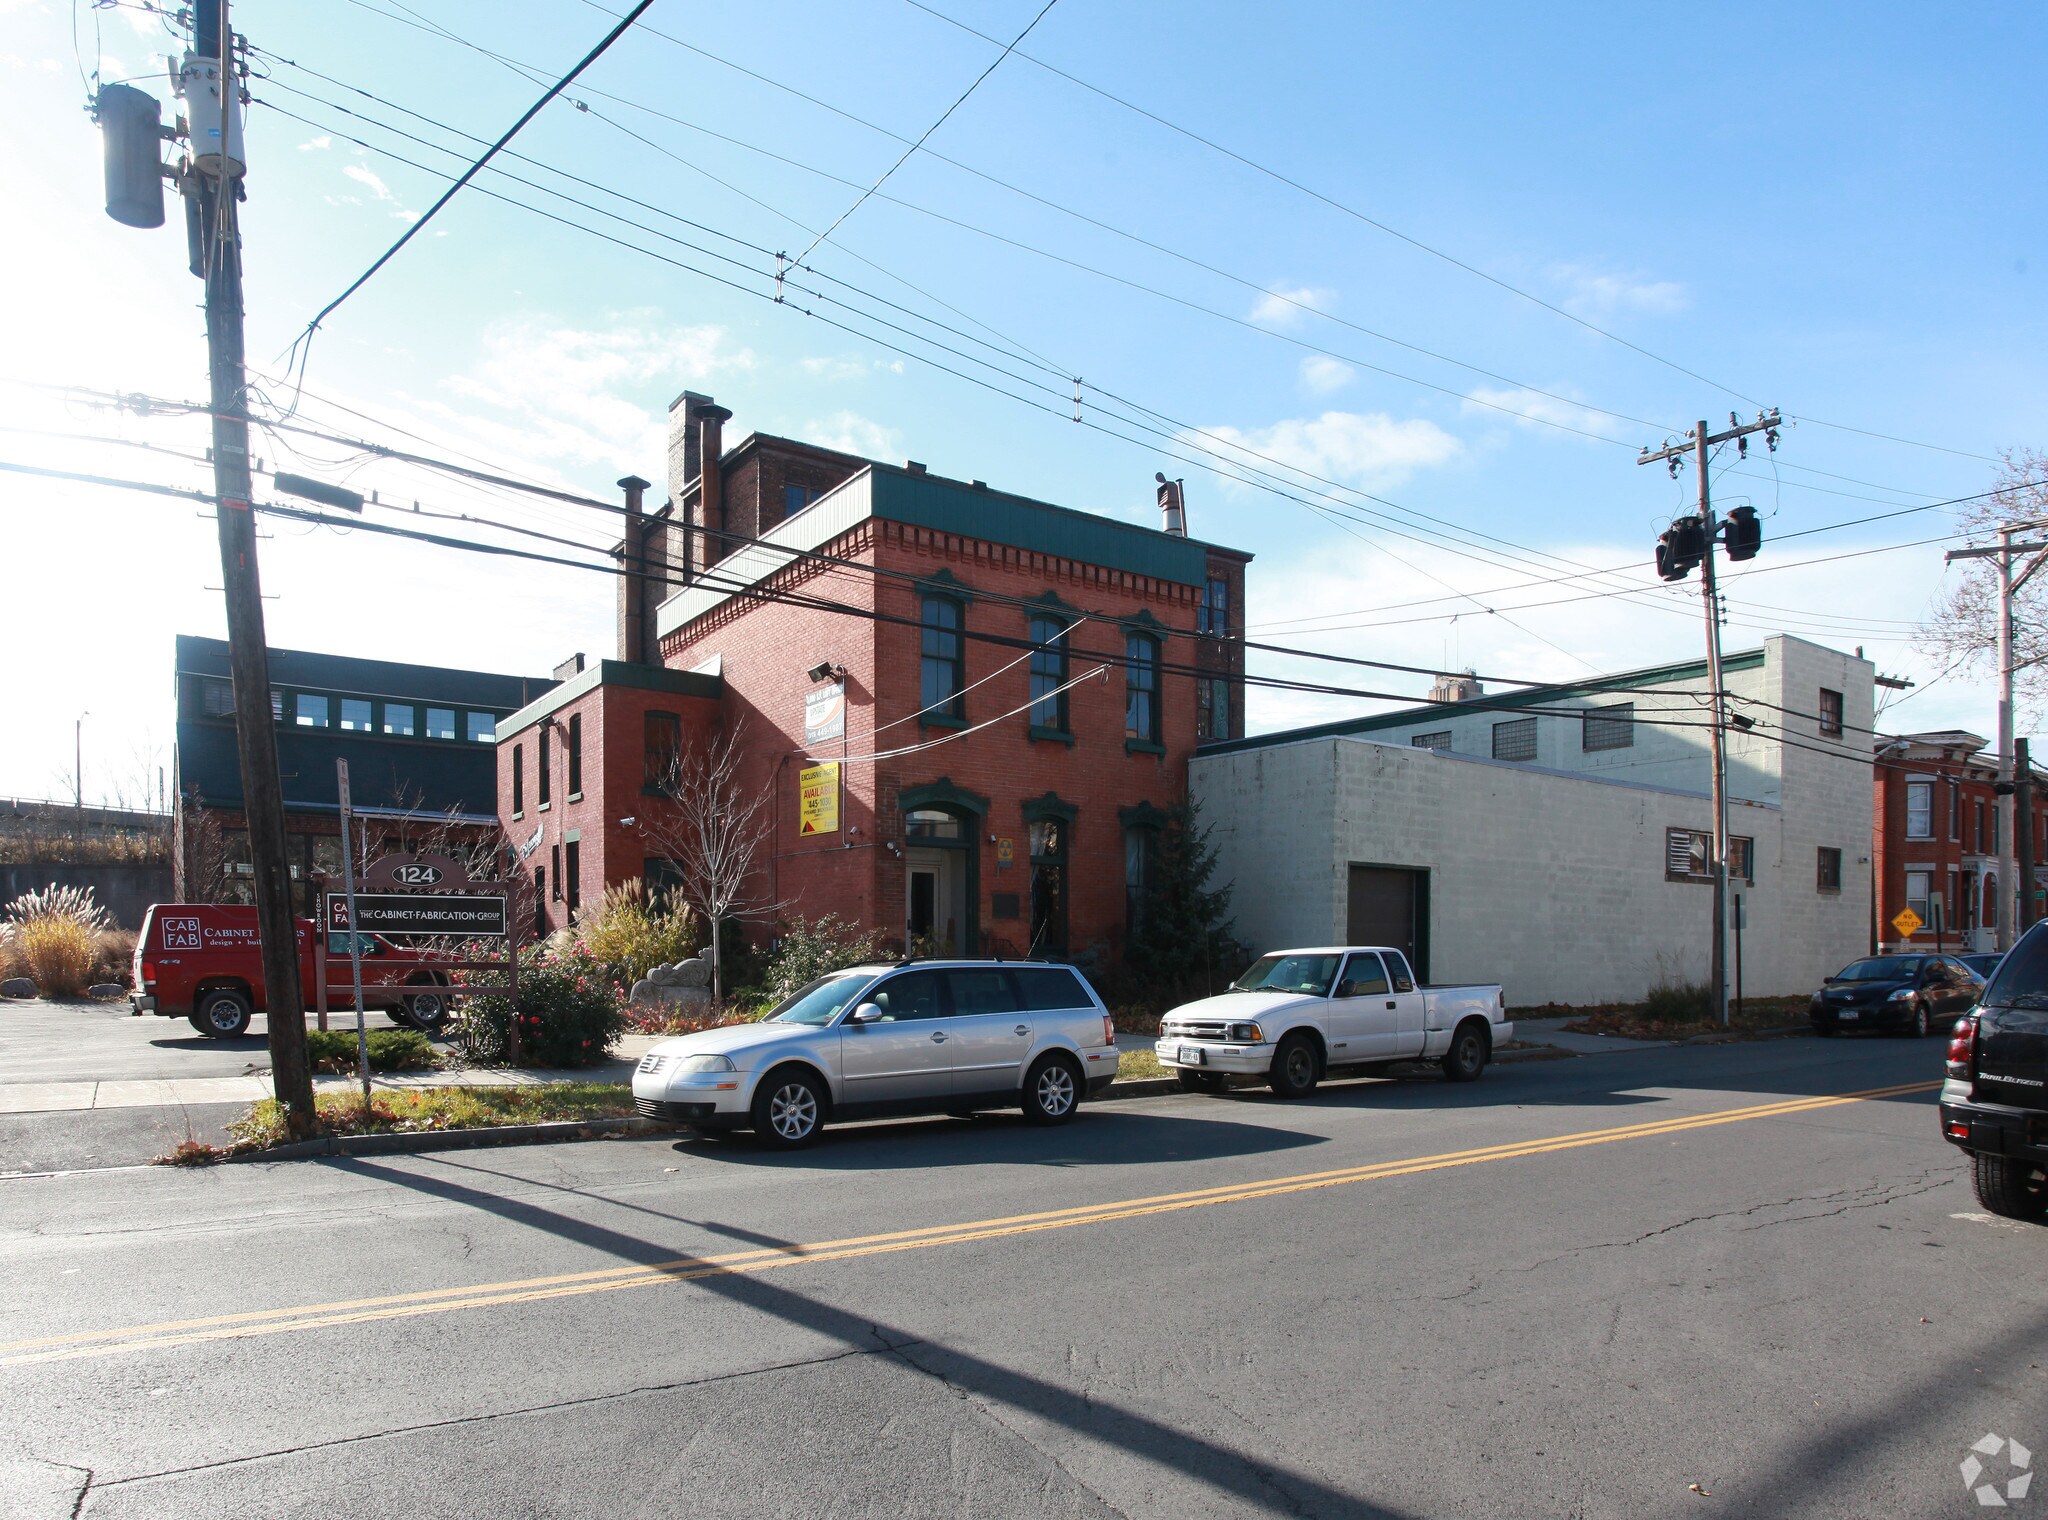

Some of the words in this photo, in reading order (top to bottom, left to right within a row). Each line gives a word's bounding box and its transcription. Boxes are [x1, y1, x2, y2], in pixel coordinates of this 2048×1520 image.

[801, 770, 822, 781] EXCLUSIVE
[823, 767, 837, 777] AGENT
[803, 784, 835, 799] AVAILABLE
[400, 867, 435, 882] 124
[334, 903, 348, 912] CA
[335, 914, 348, 922] FA
[359, 910, 374, 918] THE
[166, 920, 197, 931] CAB
[204, 928, 254, 937] CABINET
[168, 934, 198, 945] FAB
